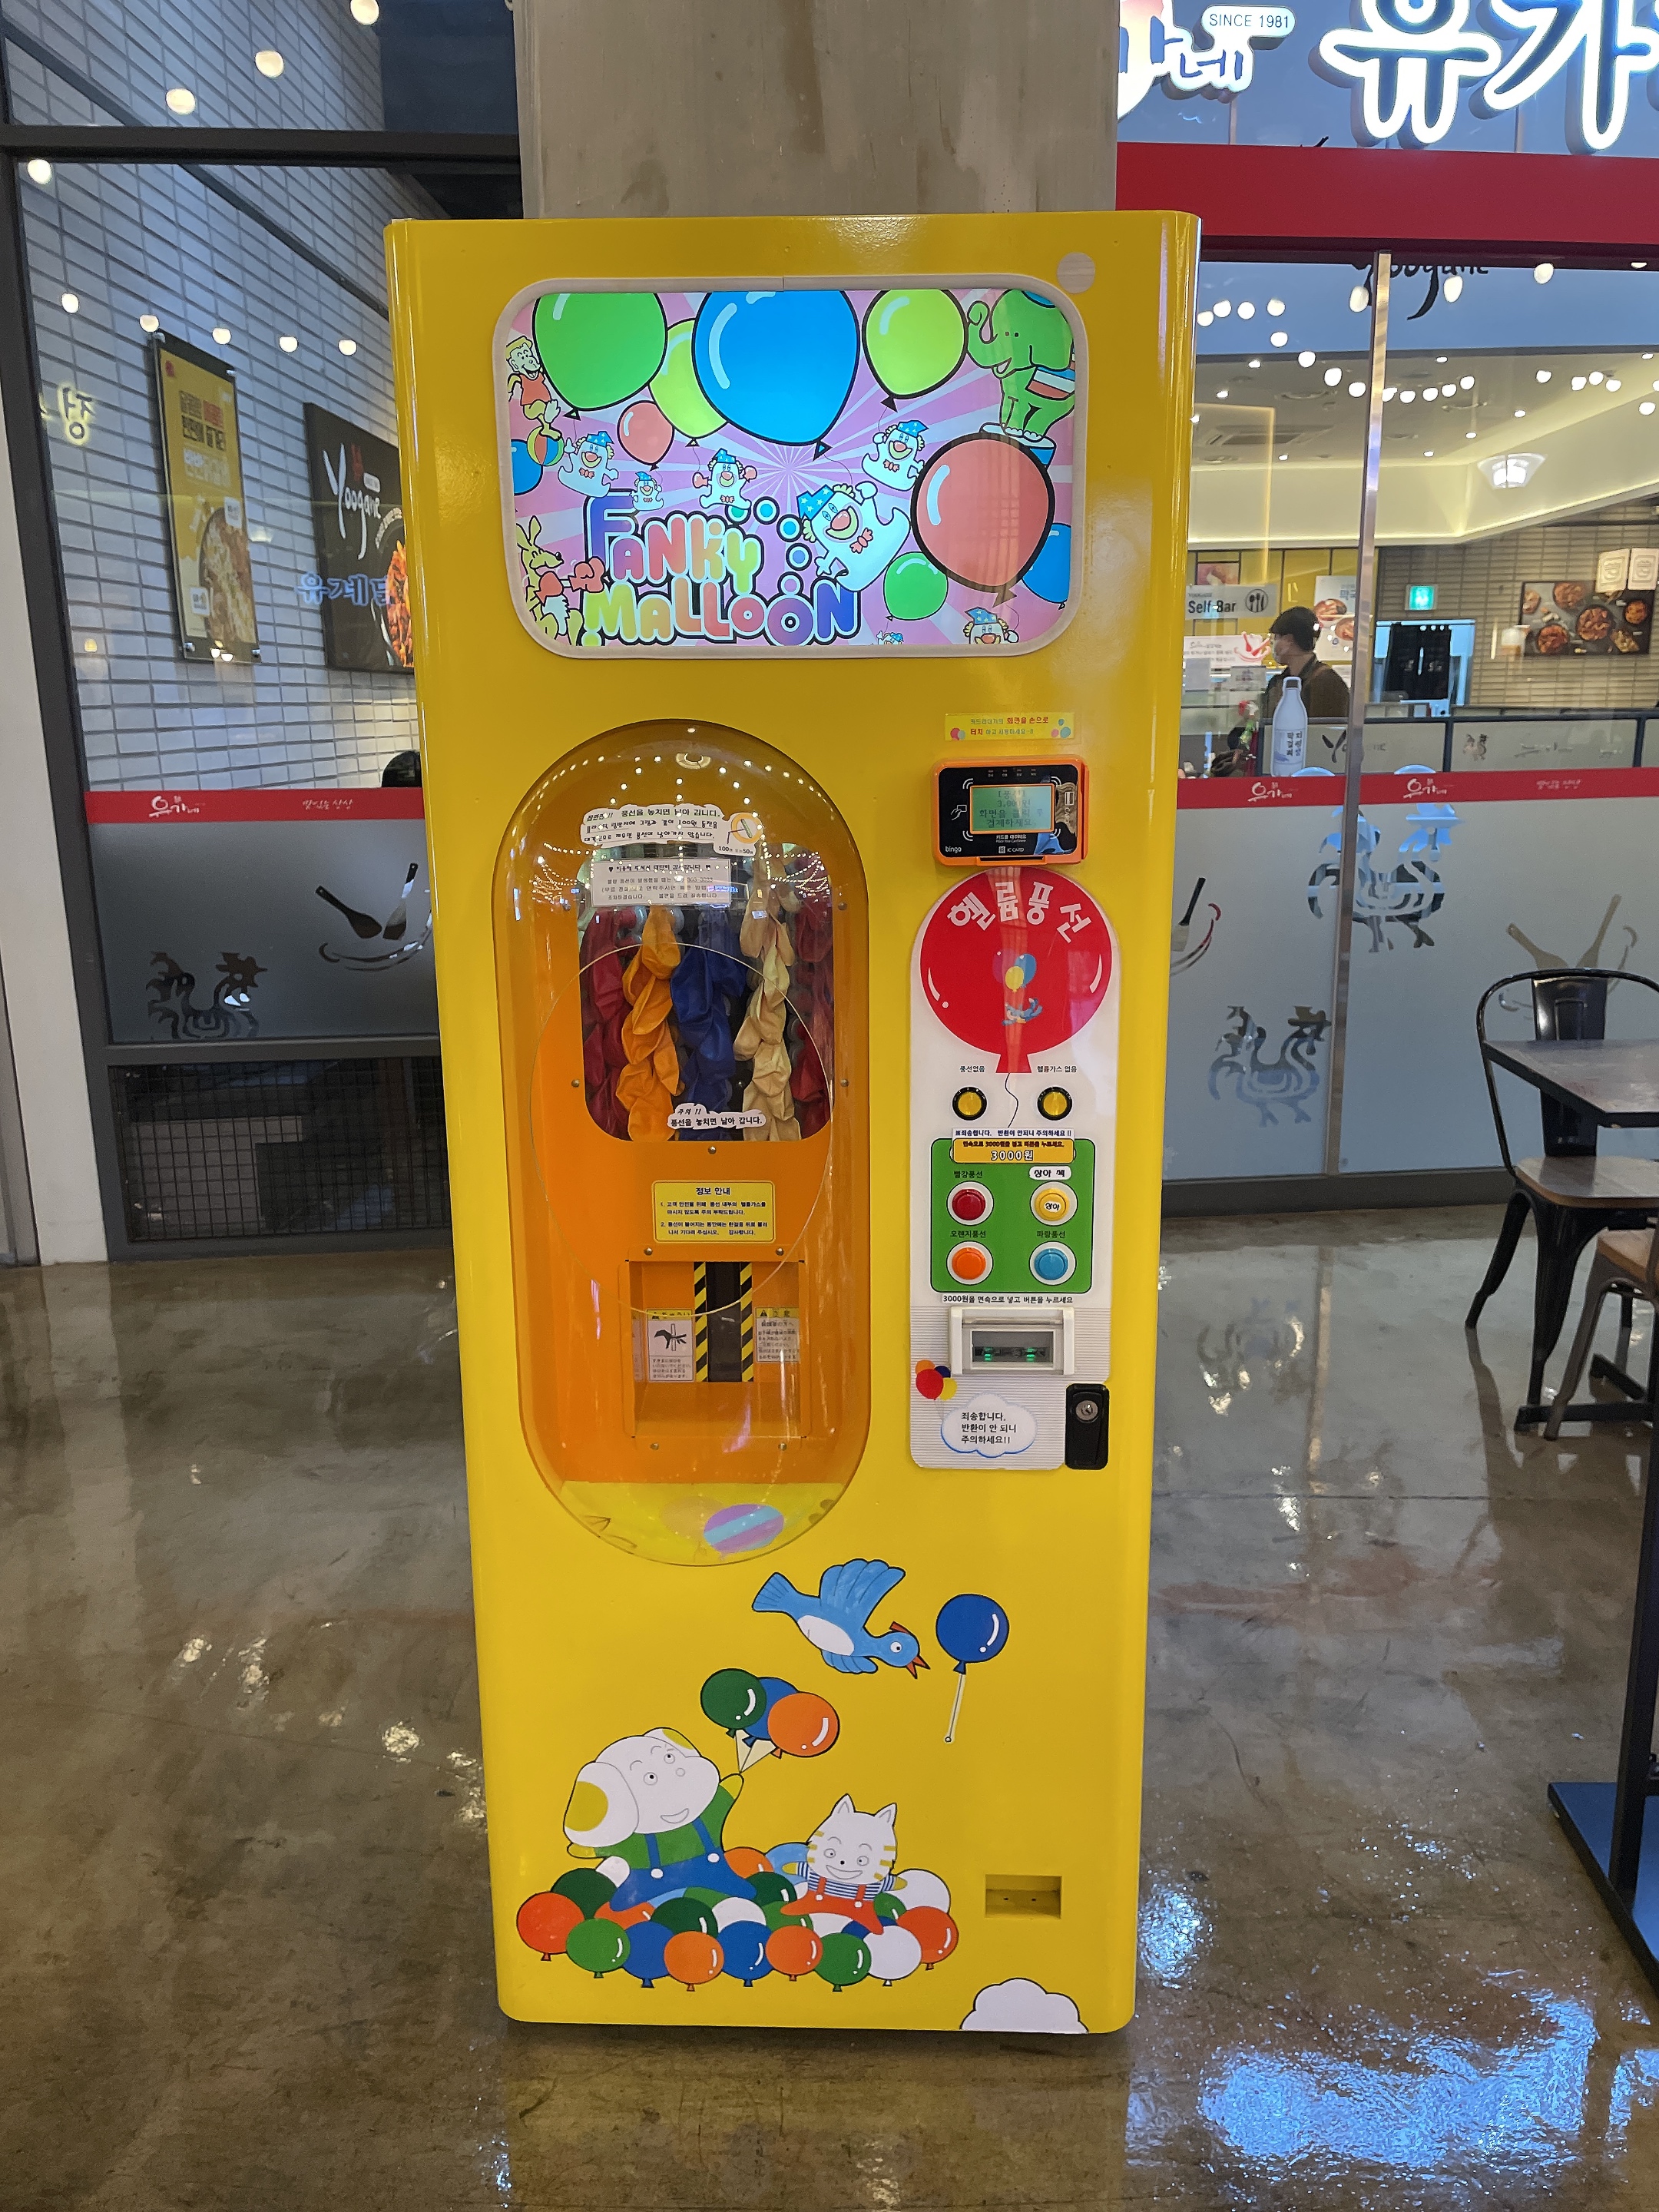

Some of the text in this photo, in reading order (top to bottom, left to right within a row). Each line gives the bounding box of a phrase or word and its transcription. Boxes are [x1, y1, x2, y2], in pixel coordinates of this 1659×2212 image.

[1209, 13, 1289, 29] SINCE 1981
[1187, 599, 1237, 614] Self Bar
[621, 809, 644, 817] 풍선을
[979, 809, 1006, 819] 화면을
[671, 1116, 763, 1127] 풍선을 놓치면 날아 갑니다.
[991, 1150, 1034, 1161] 3000원
[953, 1170, 983, 1179] 빨강풍선
[695, 1187, 731, 1196] 정보 안내
[949, 1230, 987, 1238] 오렌지풍선
[1036, 1230, 1066, 1239] 파랑풍선
[942, 1295, 1074, 1303] 3000원을 연속으로 넣고 버튼을 누르세요
[961, 1411, 1006, 1422] 죄송합니다.
[961, 1423, 1017, 1433] 반환이 안 되니
